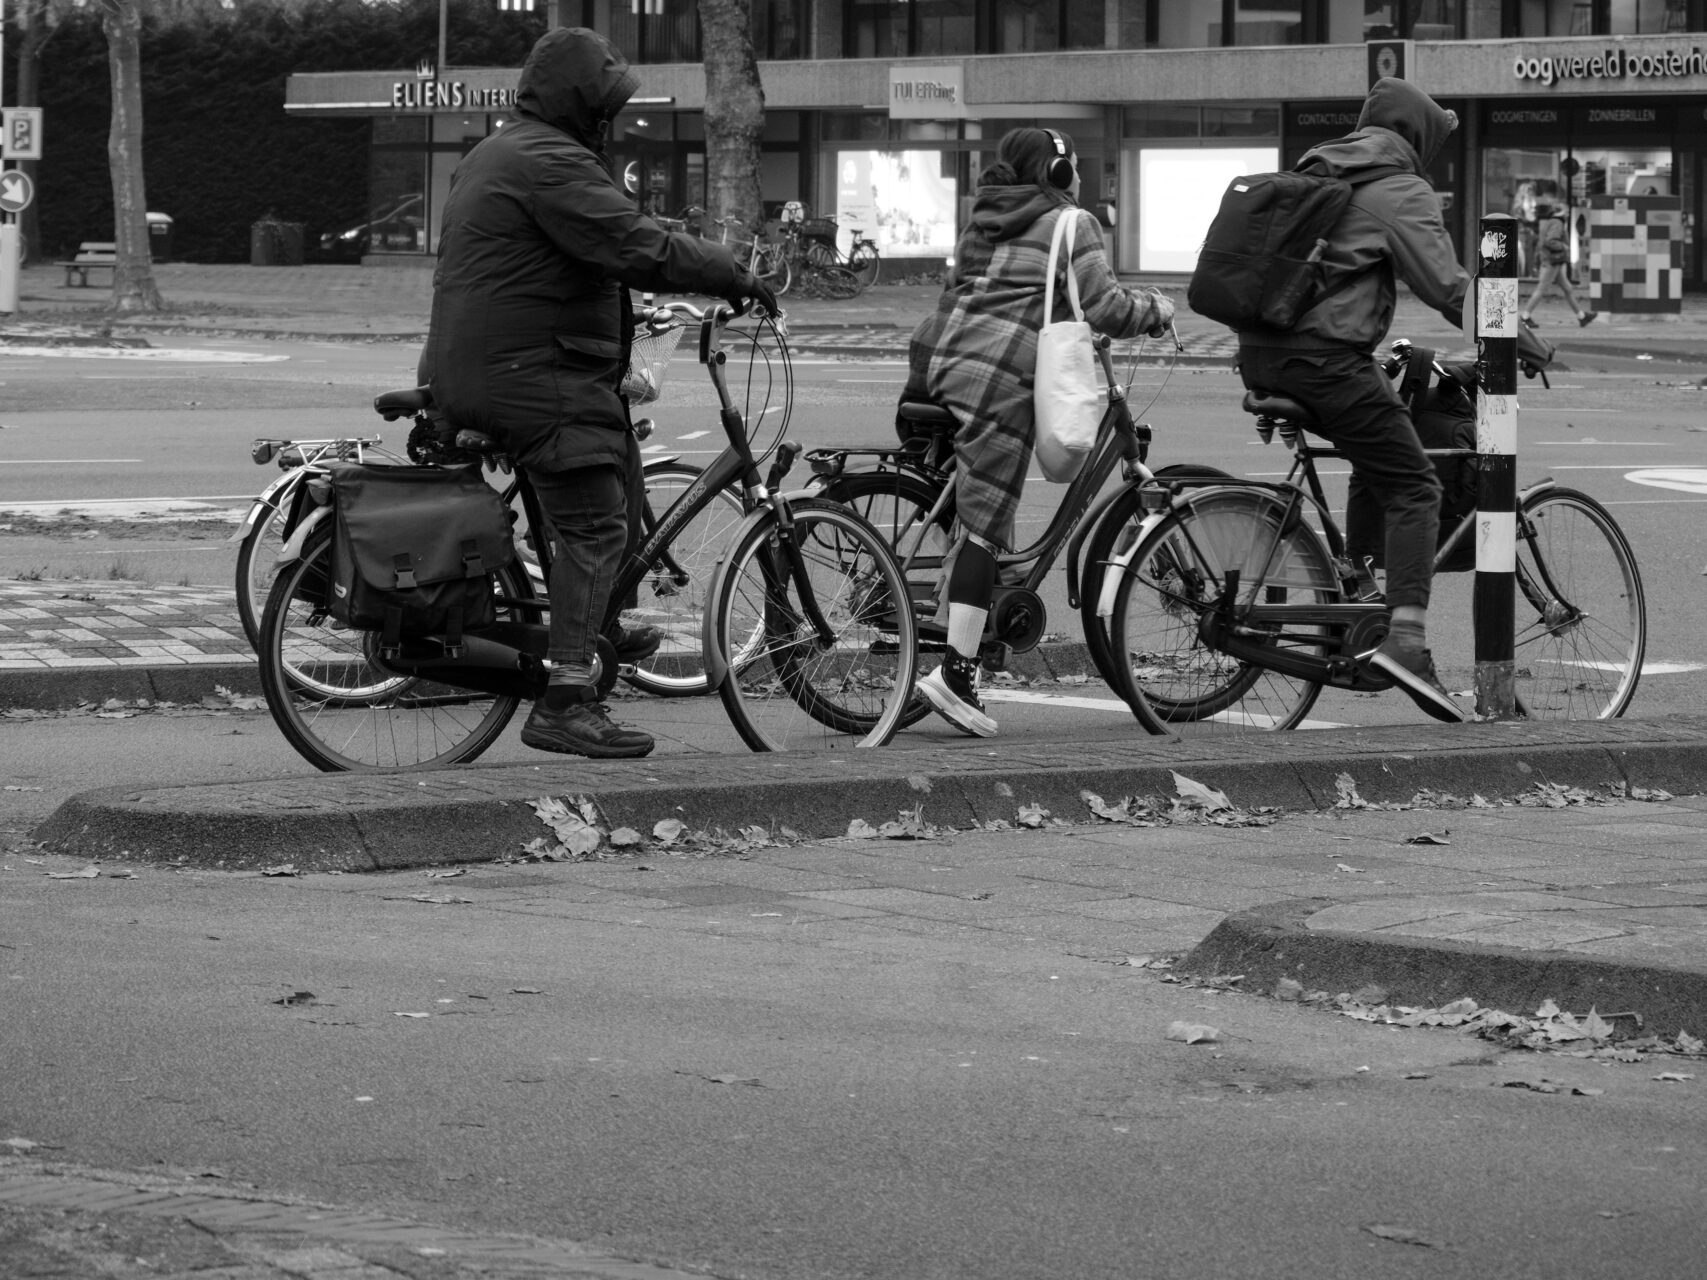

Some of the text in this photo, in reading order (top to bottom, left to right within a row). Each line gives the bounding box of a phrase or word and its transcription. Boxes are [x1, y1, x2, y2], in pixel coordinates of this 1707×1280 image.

[1514, 48, 1621, 86] oogwereld
[393, 81, 462, 107] ELIENS
[893, 81, 912, 98] TUI
[1588, 108, 1656, 122] ZONNEBRILLEN
[14, 120, 29, 138] P
[644, 483, 707, 555] BATAVUS
